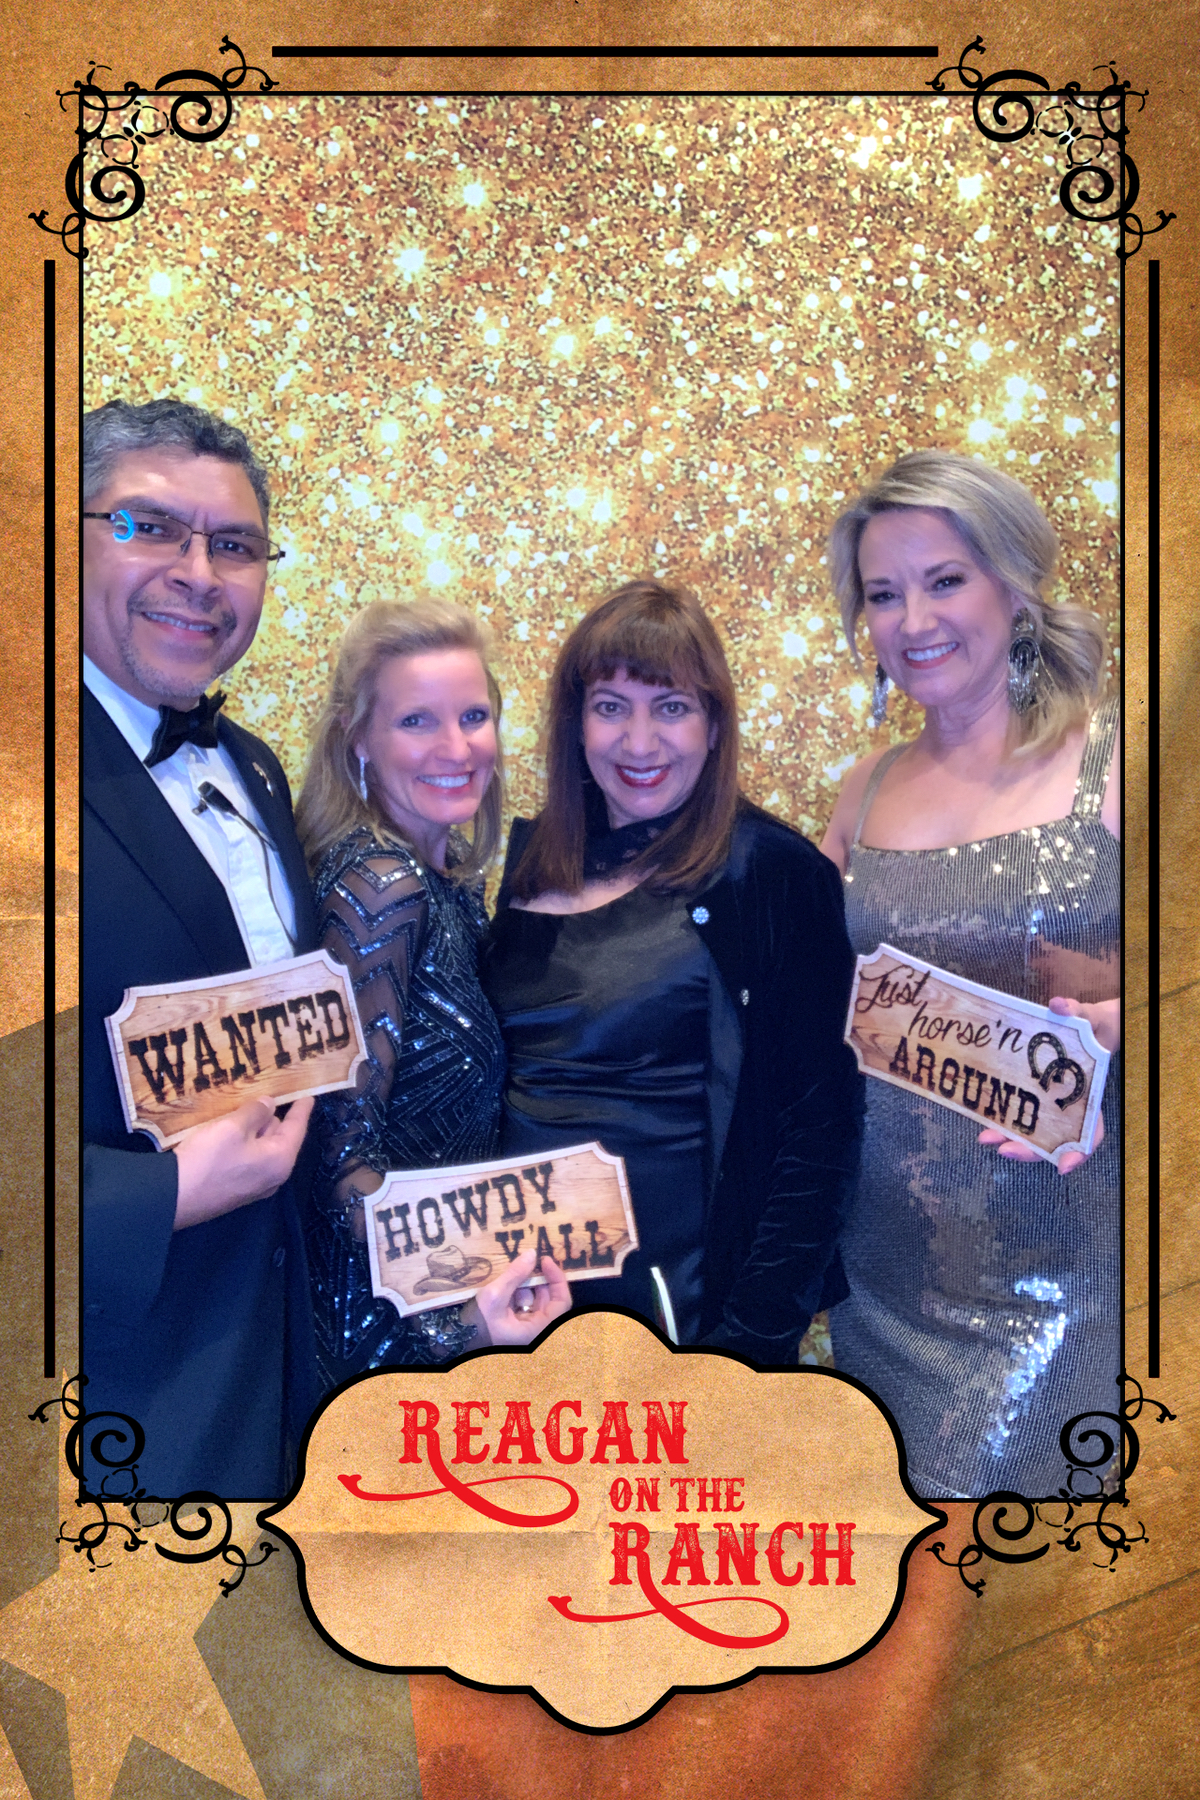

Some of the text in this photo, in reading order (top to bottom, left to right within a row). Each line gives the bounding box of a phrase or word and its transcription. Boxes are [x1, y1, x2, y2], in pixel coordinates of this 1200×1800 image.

[855, 964, 930, 1013] Just
[908, 1001, 1023, 1053] horse'n
[128, 989, 350, 1104] WANTED
[889, 1035, 1040, 1136] AROUND
[376, 1162, 556, 1264] HOWDY
[495, 1220, 615, 1274] Y'ALL
